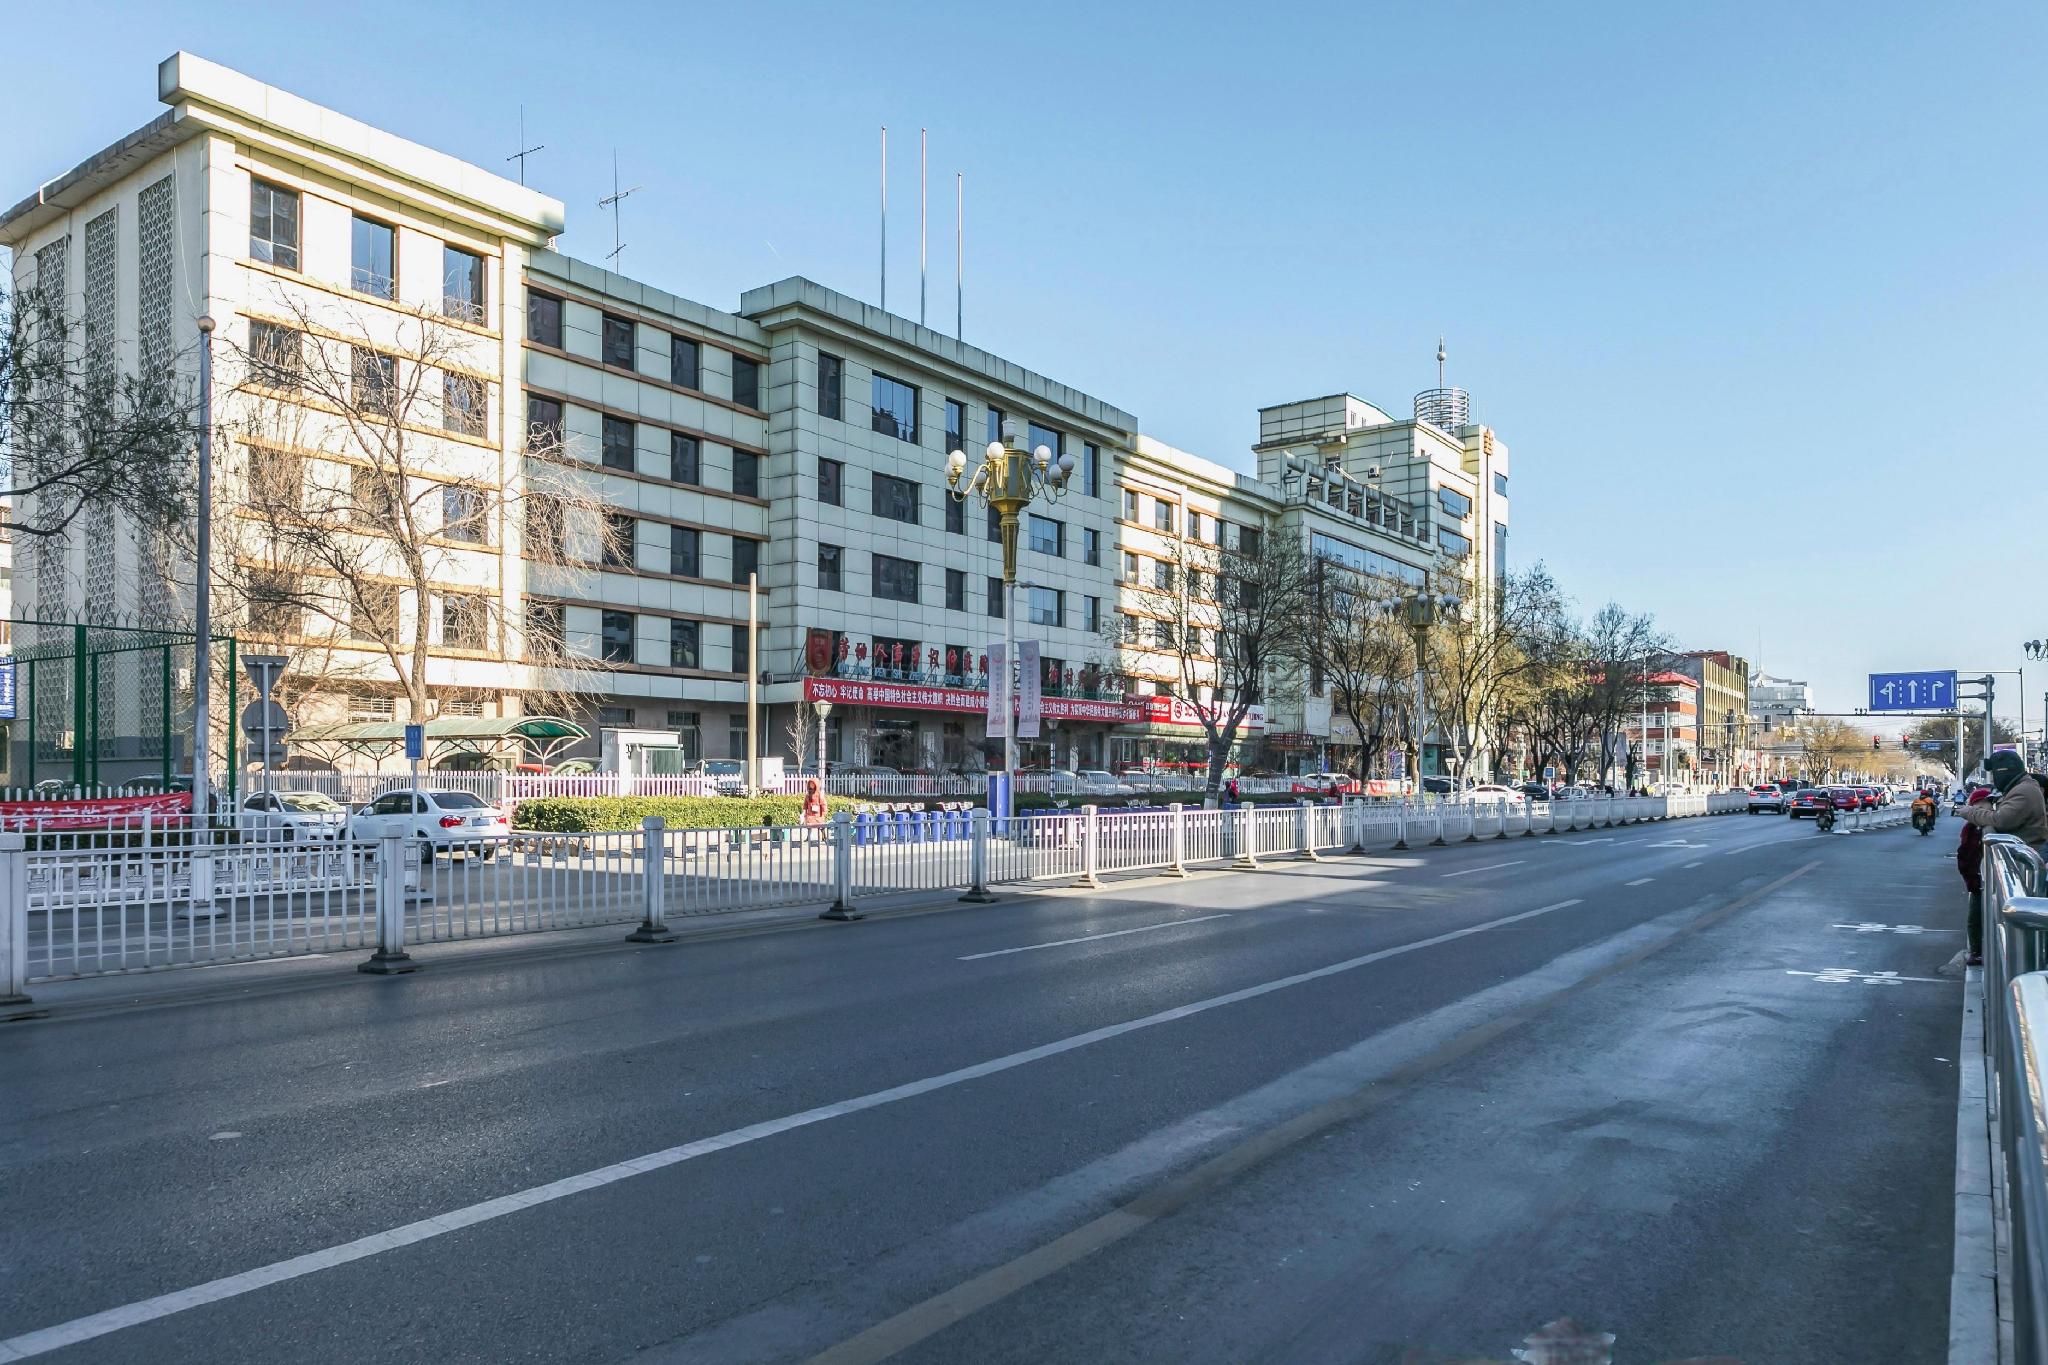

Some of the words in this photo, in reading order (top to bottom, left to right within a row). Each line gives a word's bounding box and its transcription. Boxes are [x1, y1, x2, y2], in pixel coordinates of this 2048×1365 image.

[812, 683, 837, 698] 不忘初心
[840, 685, 864, 700] 牢记使命
